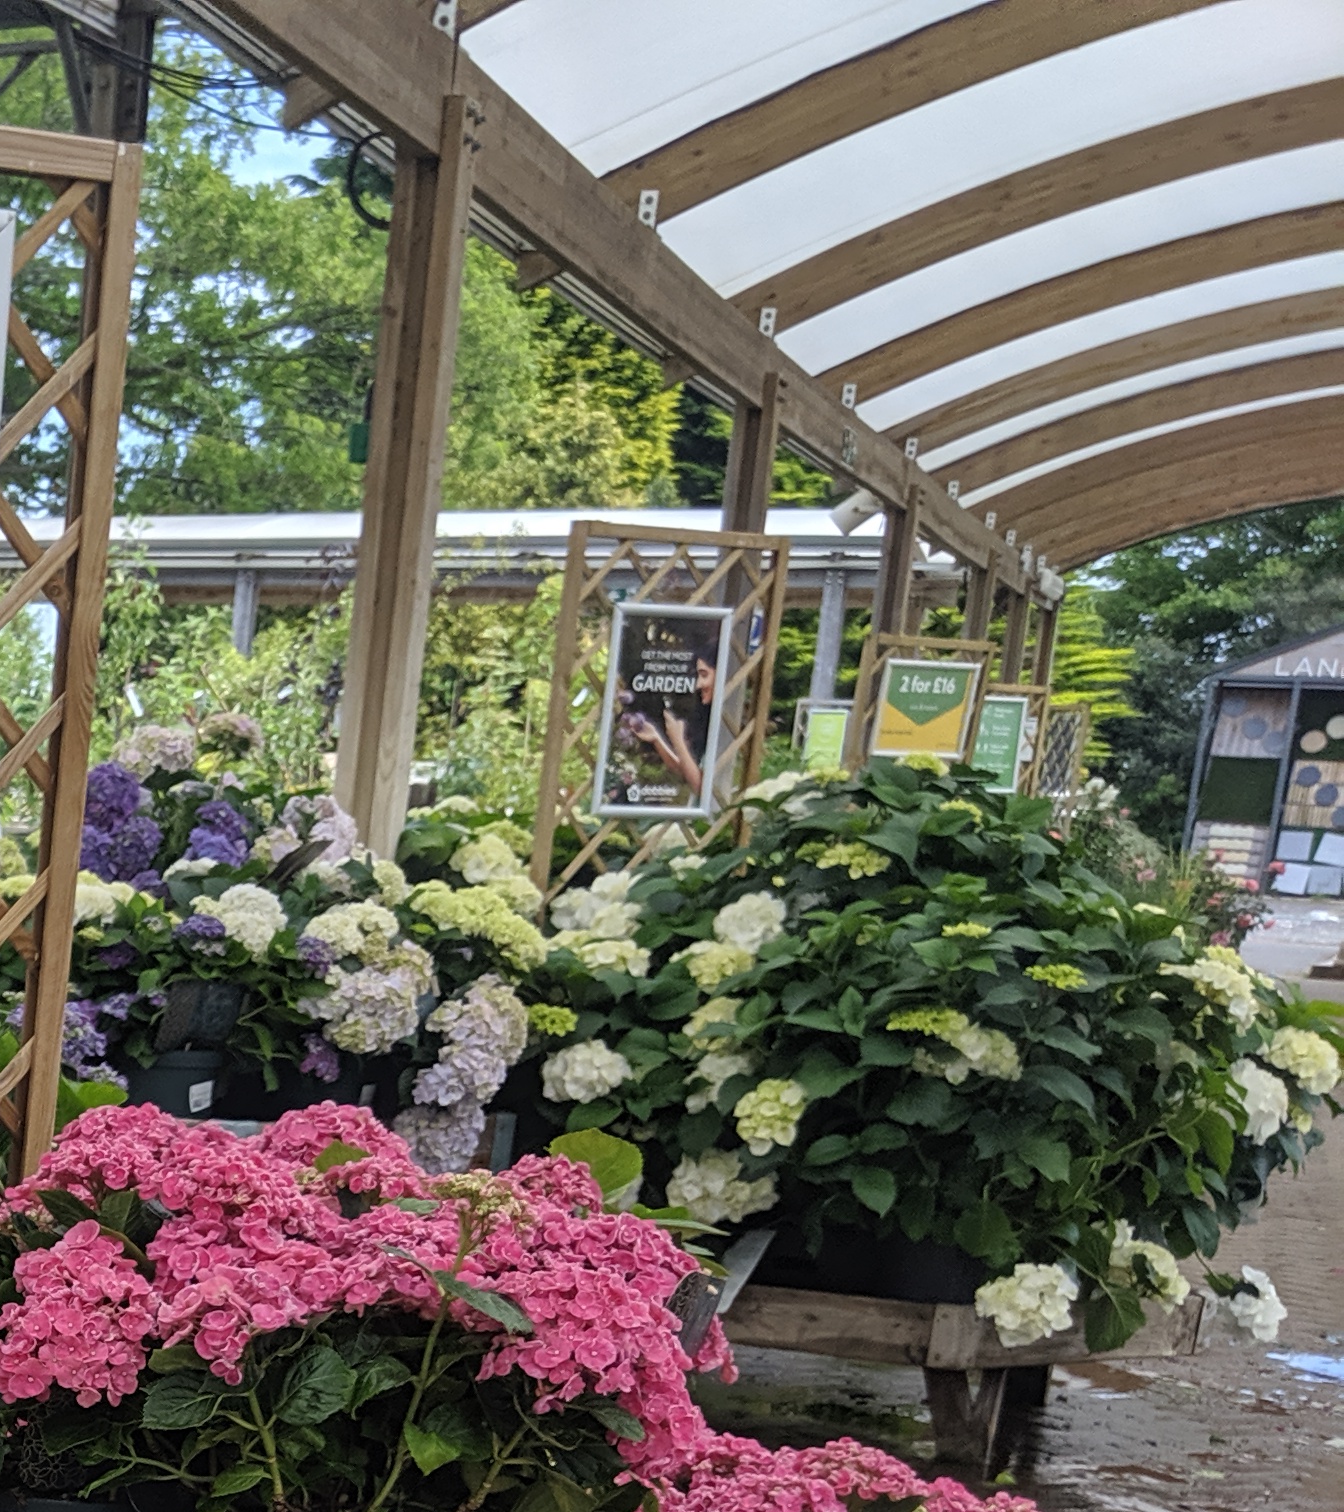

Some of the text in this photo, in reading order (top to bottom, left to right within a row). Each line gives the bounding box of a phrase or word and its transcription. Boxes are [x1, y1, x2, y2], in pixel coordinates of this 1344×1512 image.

[641, 650, 694, 662] GET THE MOST
[644, 662, 688, 674] FROM YOUR
[1274, 656, 1344, 679] LAN
[632, 673, 696, 694] GARDEN
[899, 674, 956, 695] 2 for £16
